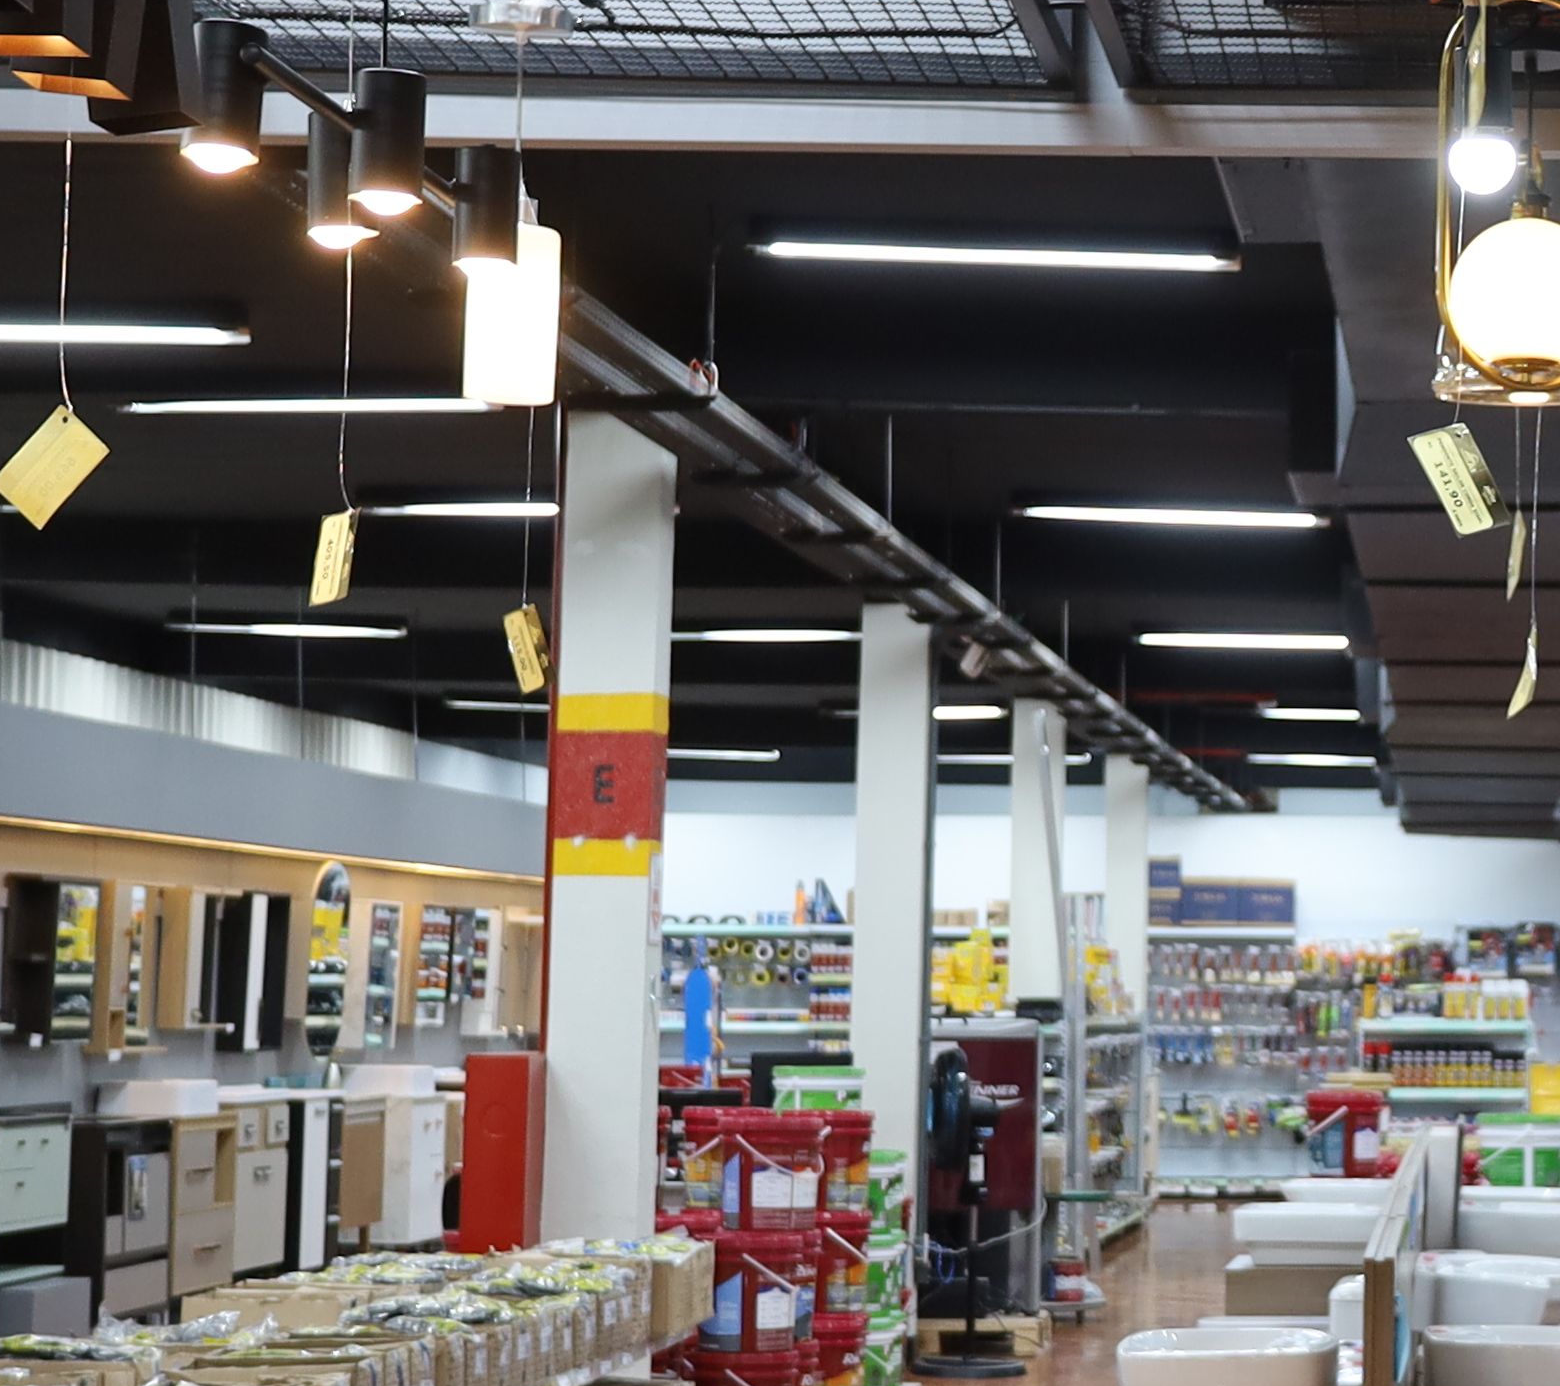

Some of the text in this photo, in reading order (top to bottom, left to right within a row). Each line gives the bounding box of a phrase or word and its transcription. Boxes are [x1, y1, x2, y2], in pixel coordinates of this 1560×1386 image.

[1433, 460, 1464, 509] 141,90
[594, 764, 615, 804] E
[970, 1084, 1020, 1096] ENNER
